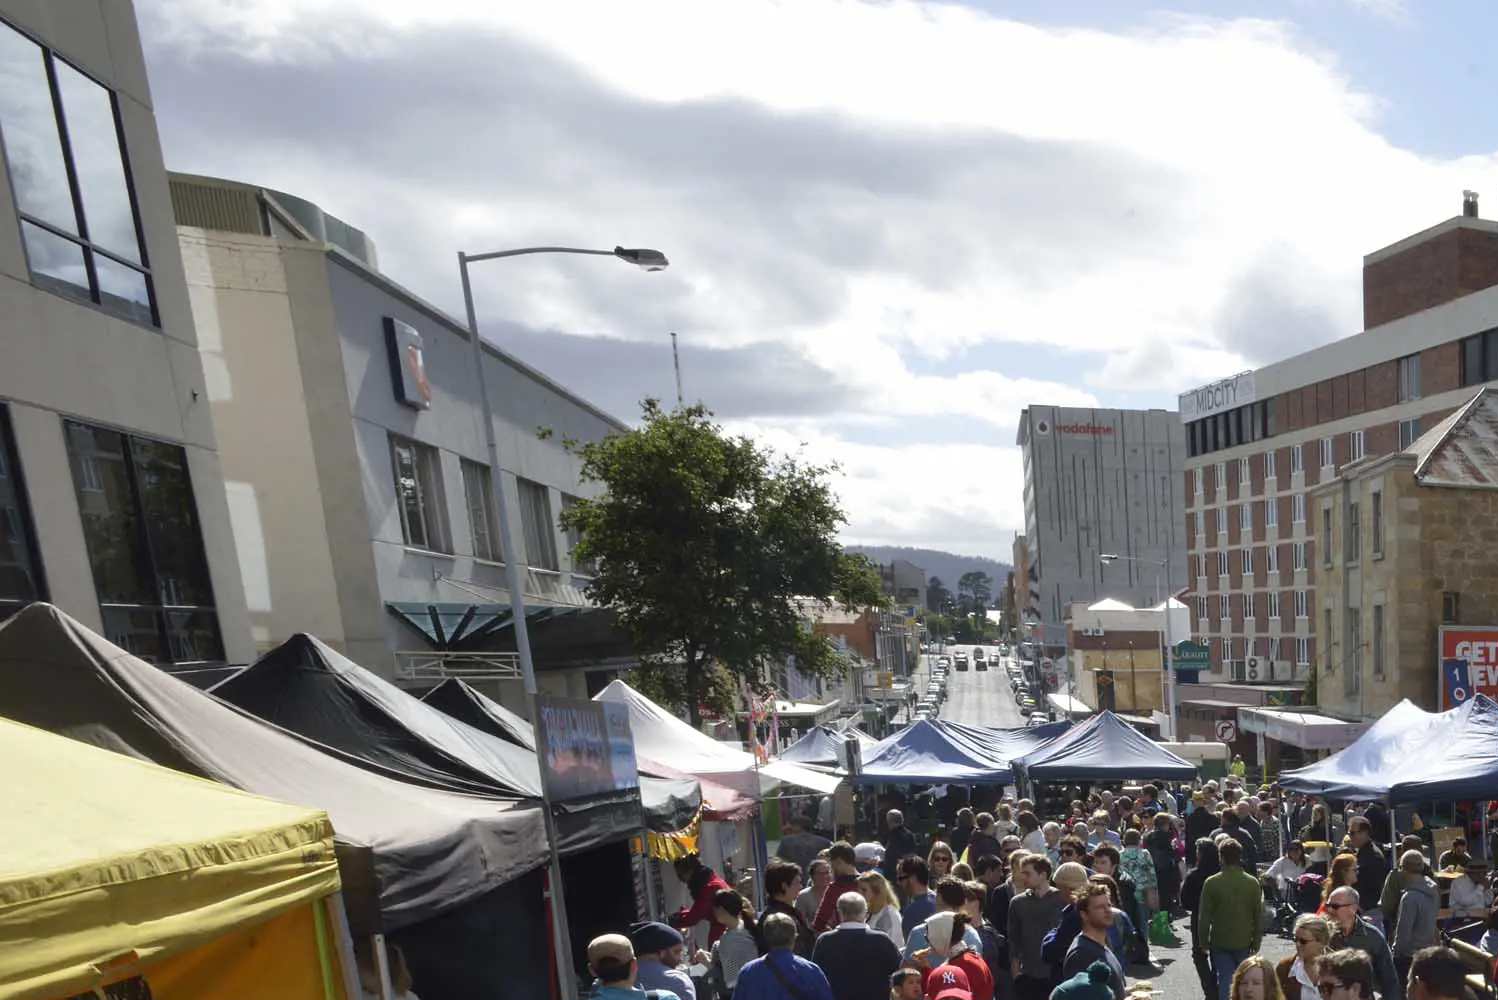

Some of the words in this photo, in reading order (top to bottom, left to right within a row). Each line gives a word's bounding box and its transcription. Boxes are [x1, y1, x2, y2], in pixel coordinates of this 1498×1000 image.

[1196, 376, 1239, 416] MIDCITY
[1056, 423, 1114, 436] vodafone
[1455, 640, 1498, 663] GET
